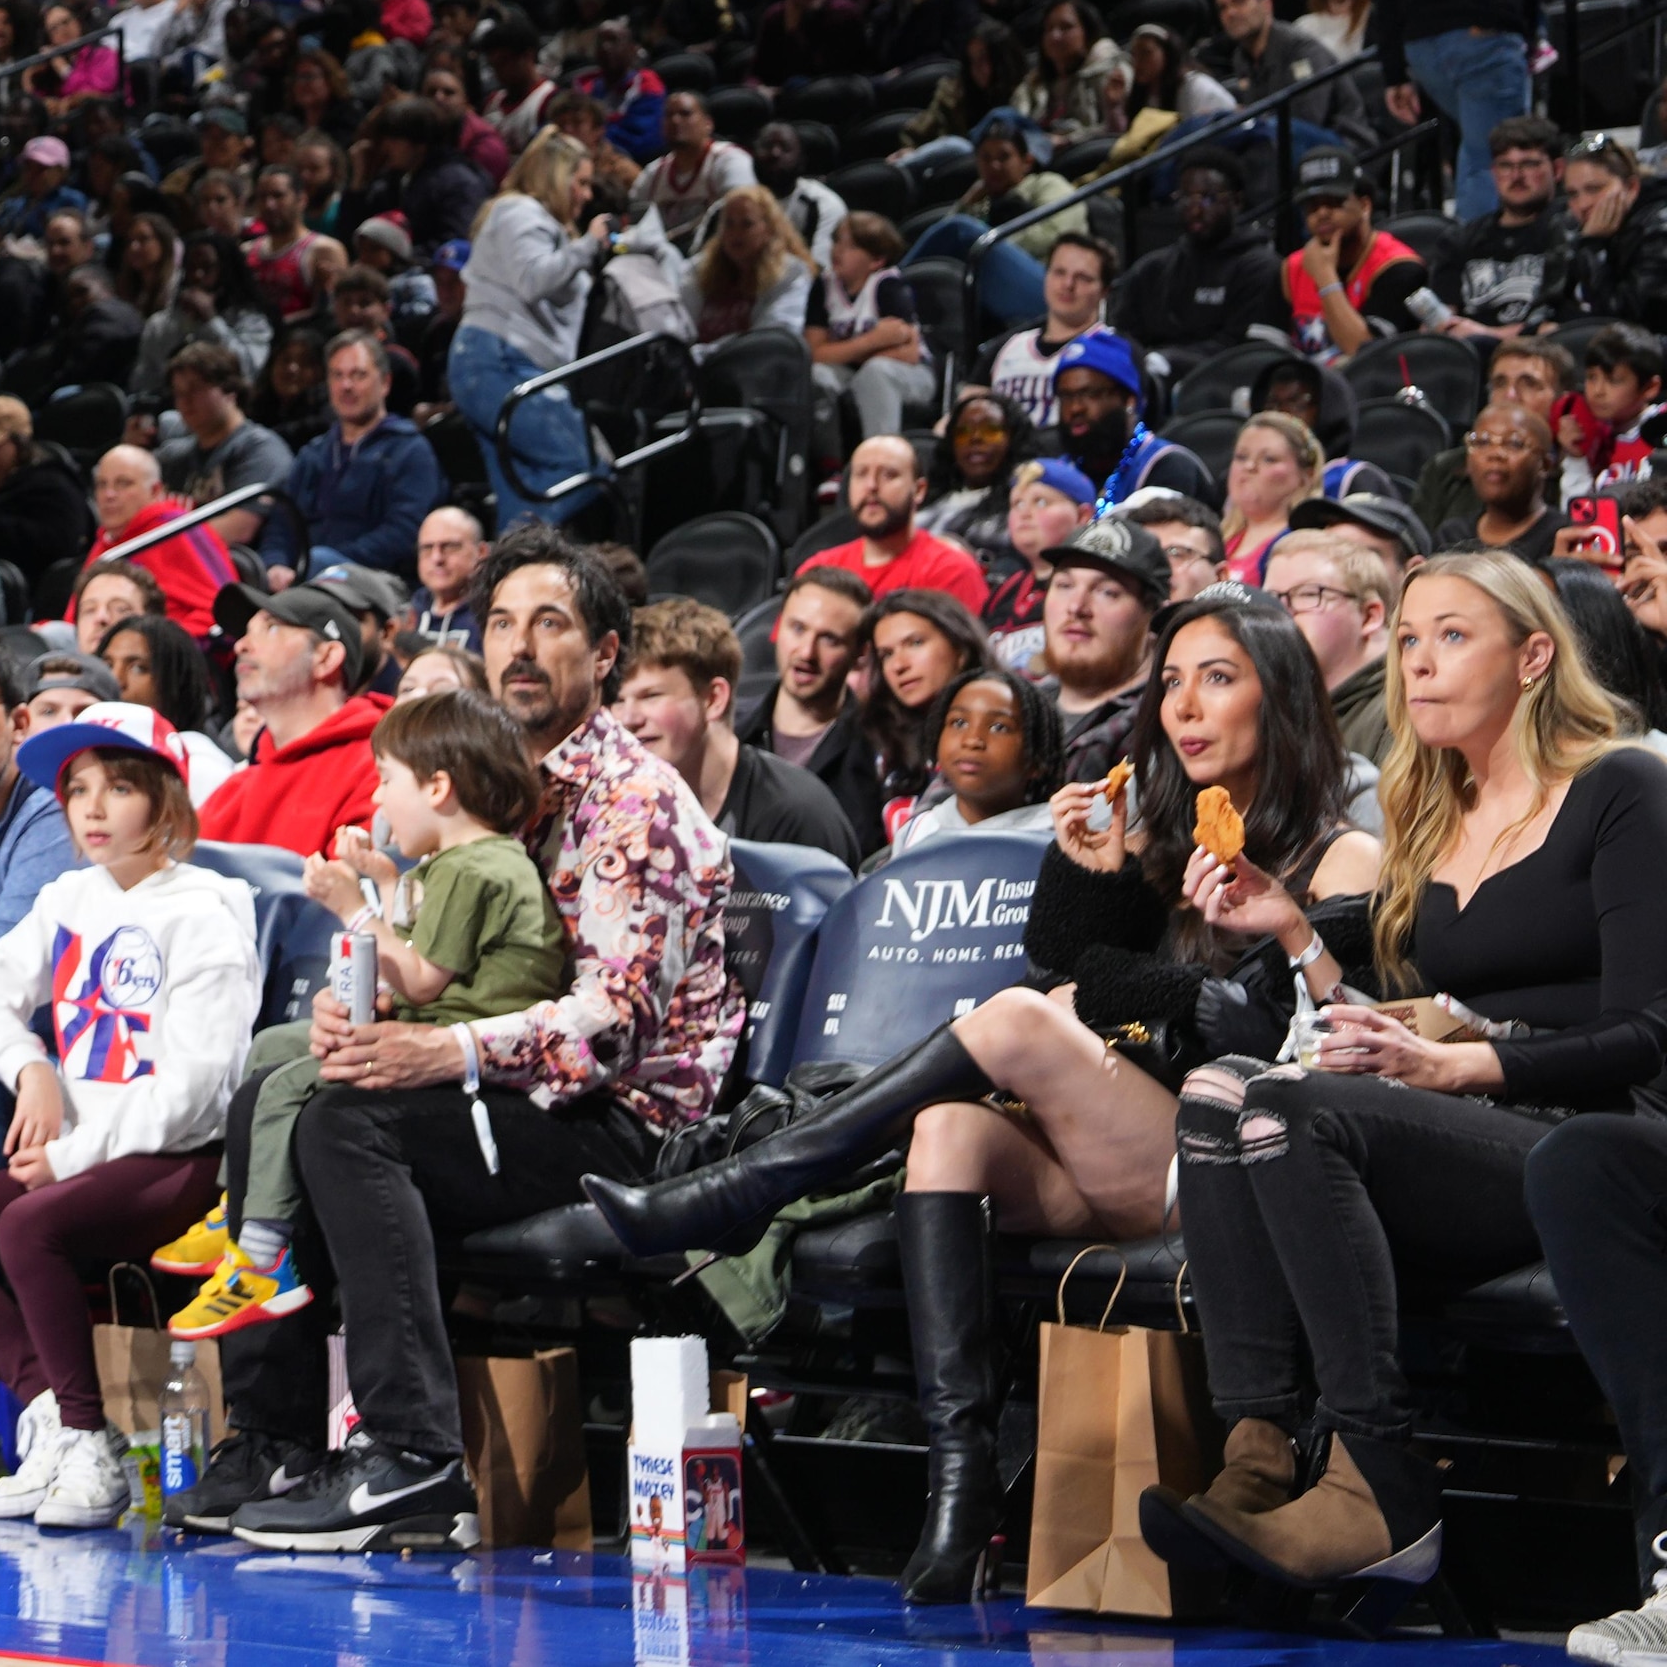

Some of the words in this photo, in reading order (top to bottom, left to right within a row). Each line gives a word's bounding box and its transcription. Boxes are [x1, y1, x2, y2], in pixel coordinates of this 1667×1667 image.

[727, 892, 791, 912] surance
[874, 878, 997, 942] NJM
[996, 879, 1036, 900] Insu
[990, 903, 1030, 926] Grou
[993, 943, 1025, 961] REN
[340, 964, 354, 1006] TRA
[163, 1414, 183, 1490] smart
[633, 1453, 675, 1476] TYRESE
